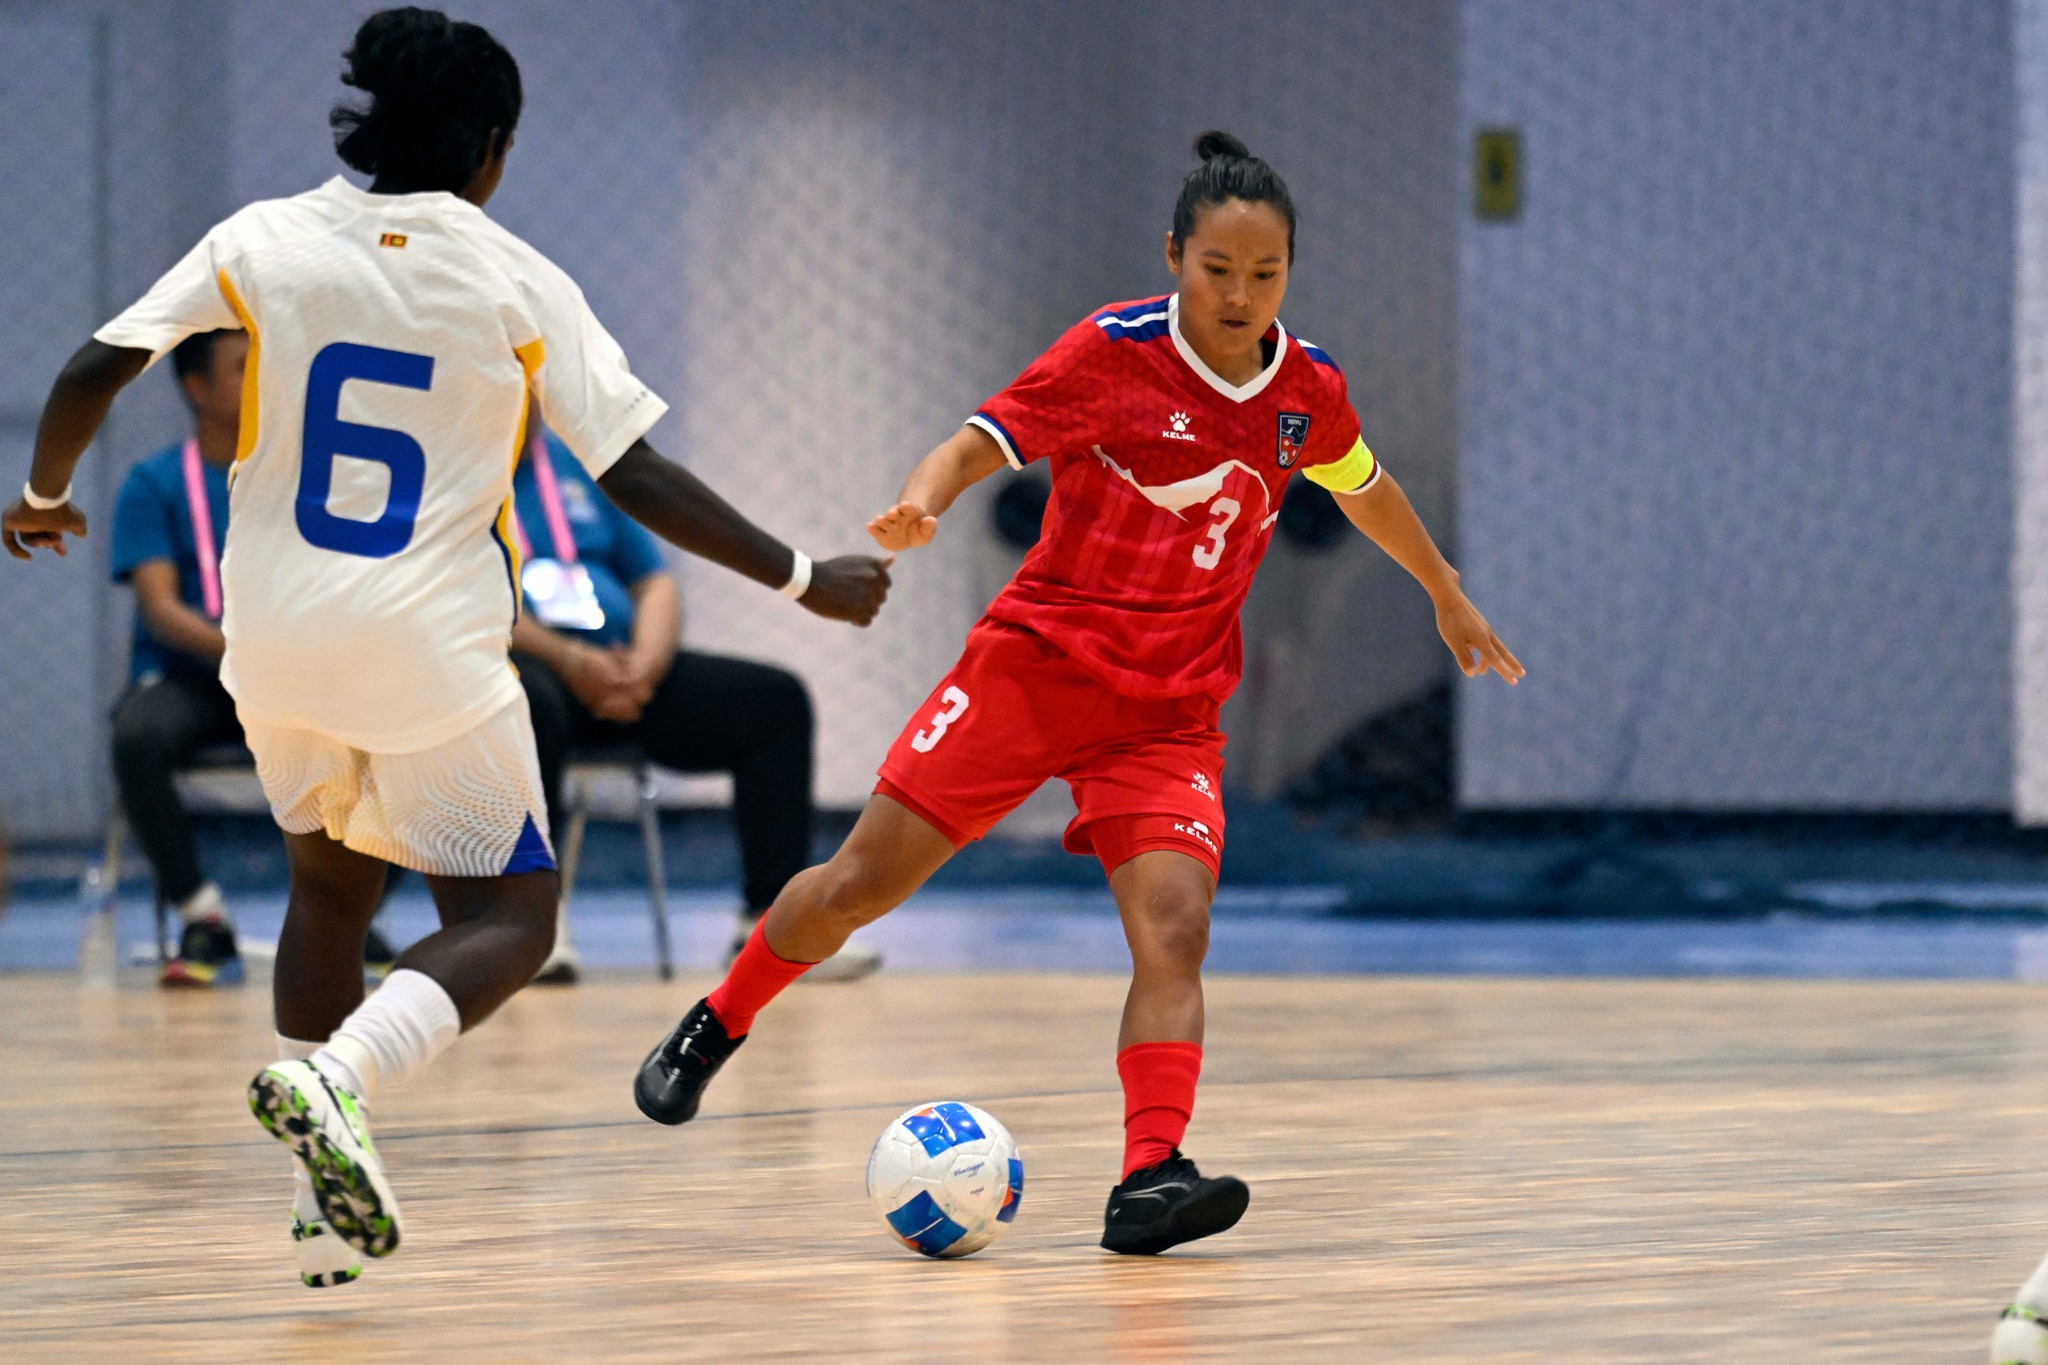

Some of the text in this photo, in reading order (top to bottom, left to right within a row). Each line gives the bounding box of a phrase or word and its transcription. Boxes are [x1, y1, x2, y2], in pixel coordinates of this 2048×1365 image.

[294, 341, 435, 560] 6
[1162, 430, 1196, 442] KELME
[1191, 496, 1241, 571] 3
[911, 685, 970, 754] 3
[1191, 782, 1216, 802] KELME
[1174, 822, 1218, 856] KELME
